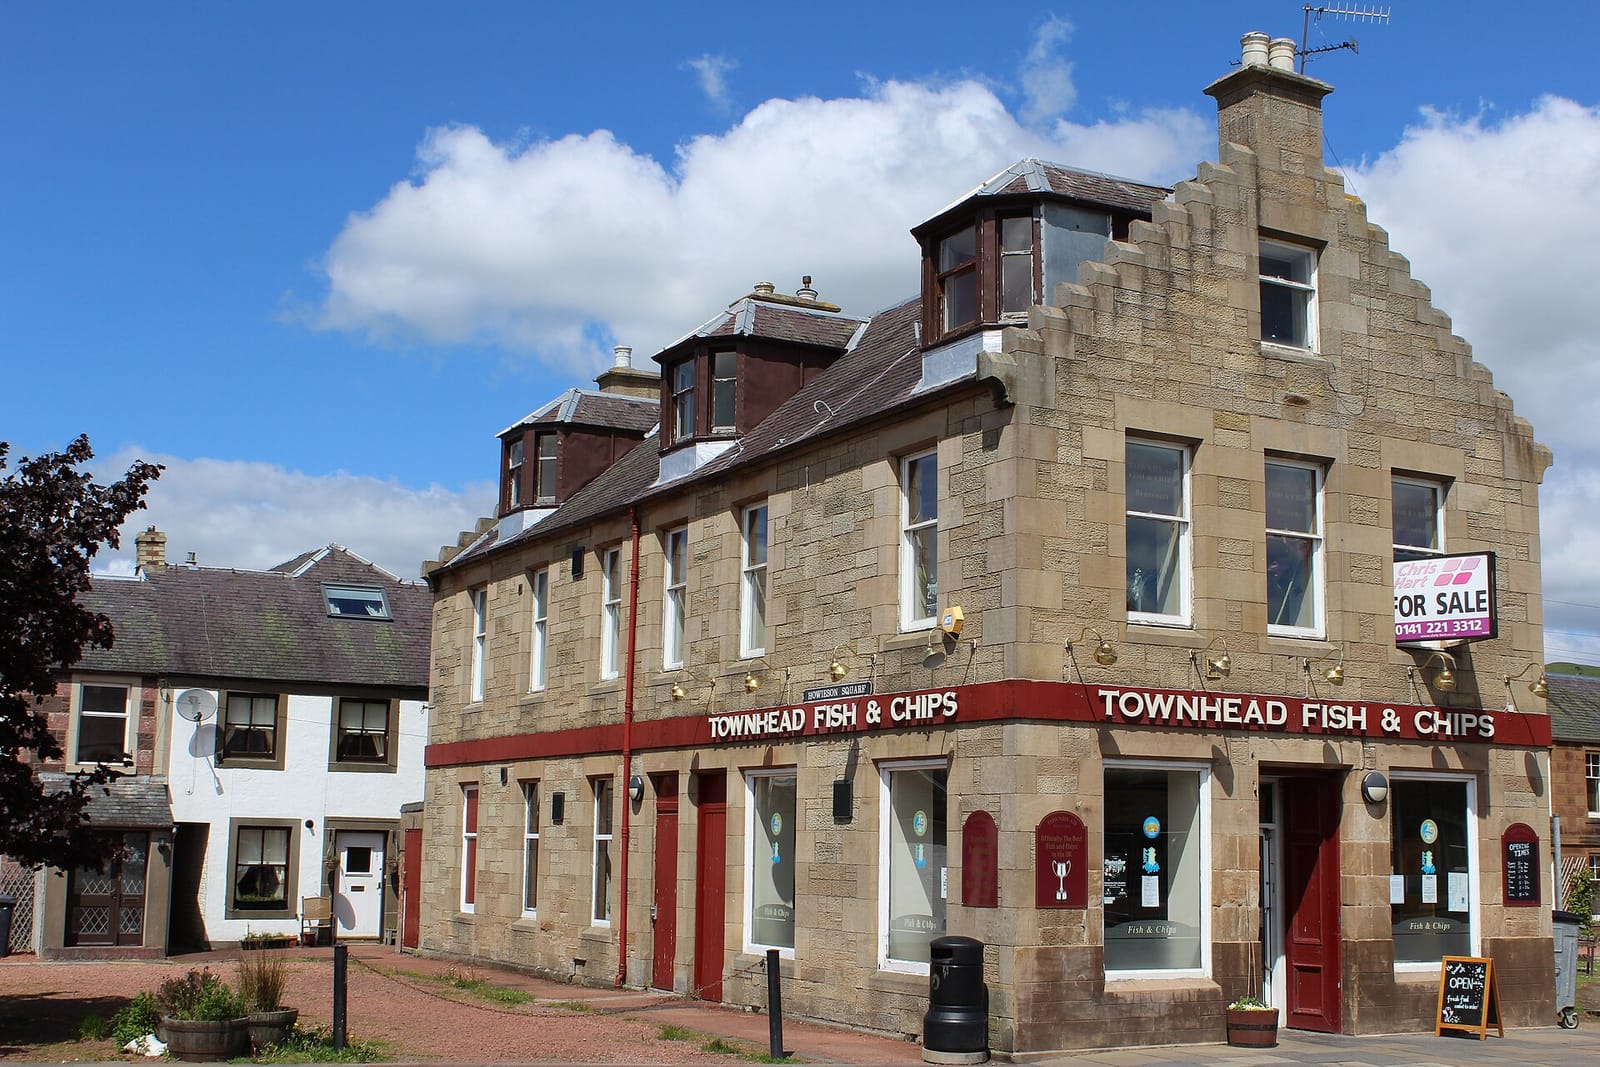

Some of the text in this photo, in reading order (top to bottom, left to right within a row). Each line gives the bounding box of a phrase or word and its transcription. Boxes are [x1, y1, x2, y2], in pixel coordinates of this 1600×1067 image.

[1398, 561, 1438, 577] Chris
[1394, 575, 1428, 590] Hart
[1436, 589, 1488, 615] SALE
[1395, 623, 1422, 636] 0141
[1426, 622, 1448, 634] 221
[1453, 619, 1482, 632] 3312
[708, 691, 958, 738] TOWNHEAD FISH & CHIPS
[1098, 689, 1495, 738] TOWNHEAD FISH & CHIPS
[1509, 843, 1530, 851] OPENING
[1513, 848, 1530, 857] TIMES
[1127, 925, 1177, 936] Fish & Chips
[1409, 921, 1451, 931] Fish & Chips
[1449, 977, 1474, 990] OPEN
